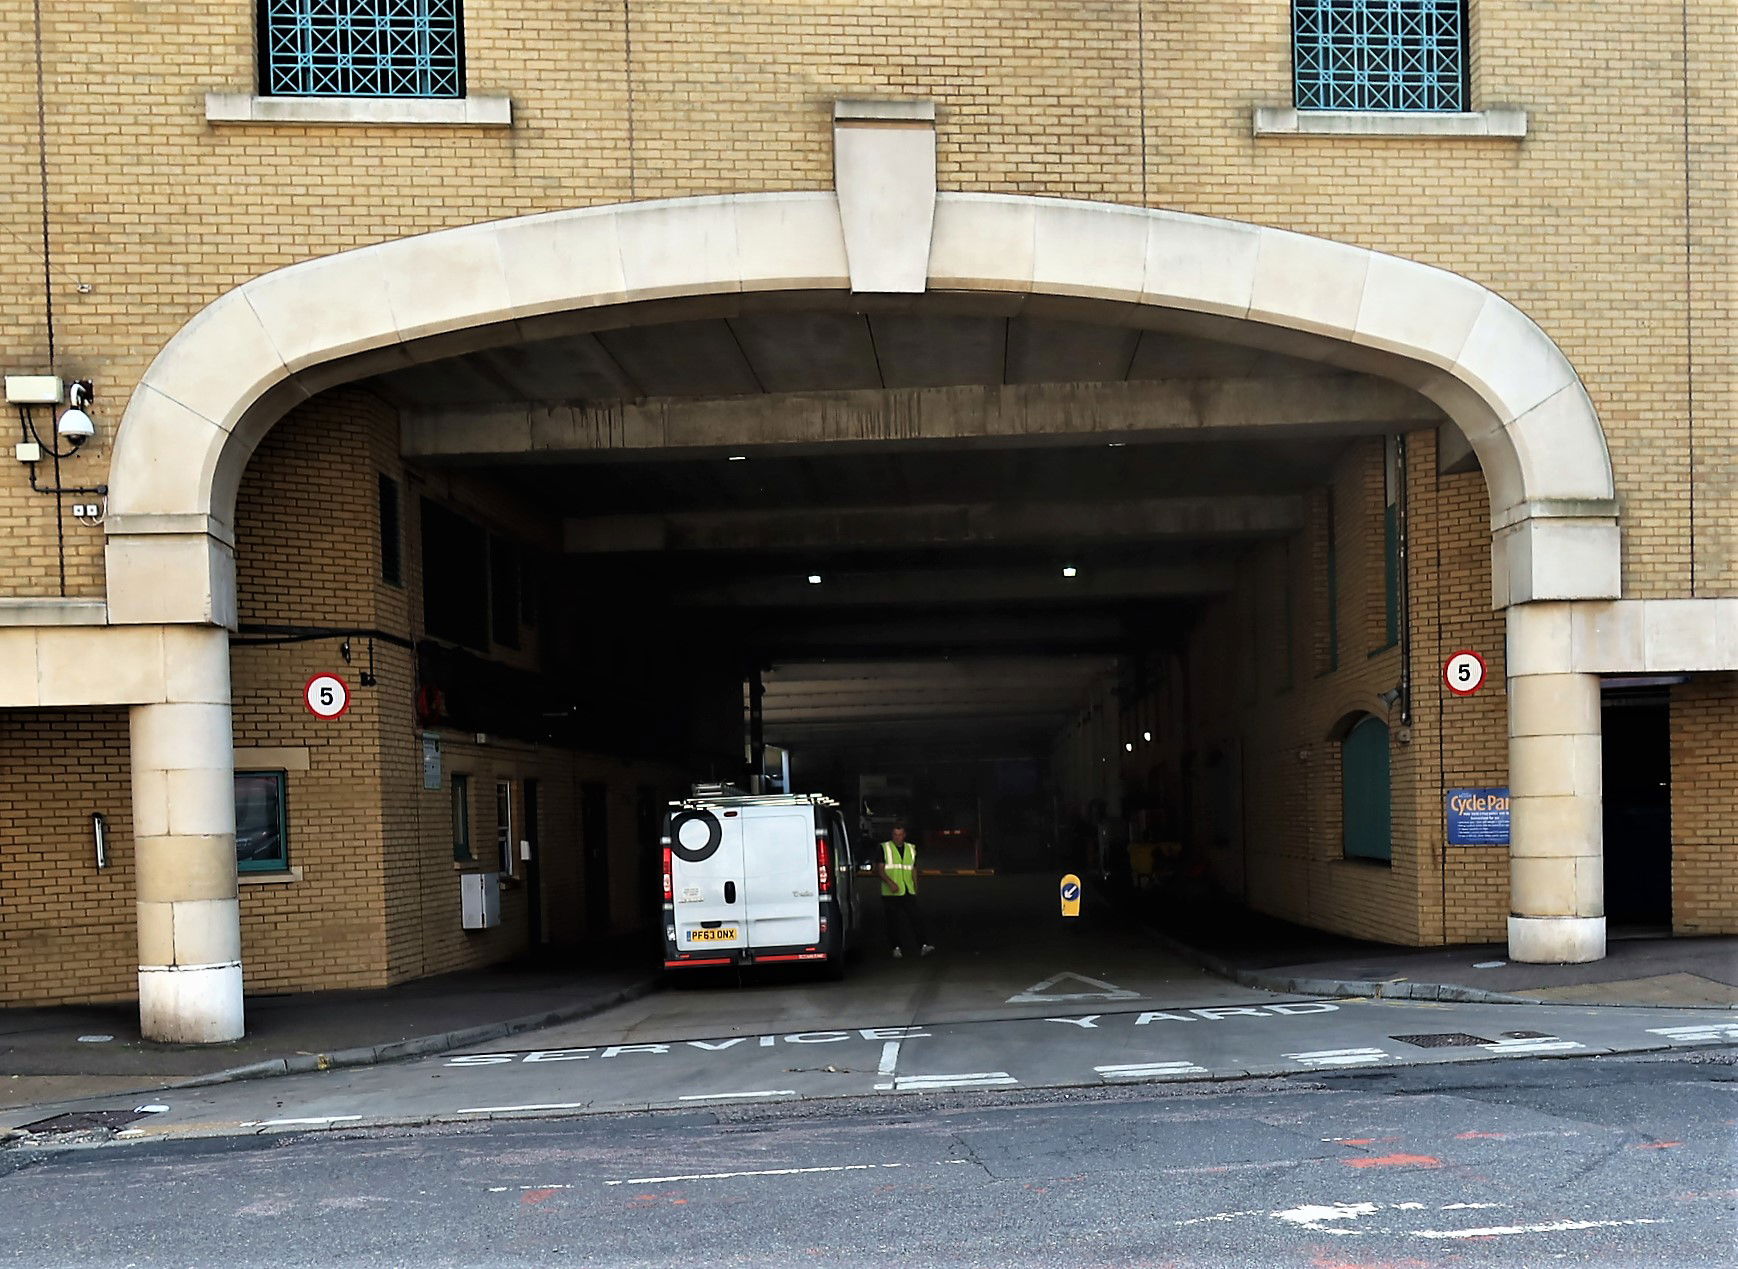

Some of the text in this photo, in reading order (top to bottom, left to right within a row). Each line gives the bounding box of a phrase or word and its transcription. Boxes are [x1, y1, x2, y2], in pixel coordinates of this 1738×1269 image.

[1458, 663, 1471, 681] 5
[320, 687, 333, 705] 5
[1451, 794, 1486, 816] Cycle
[692, 929, 735, 940] PF63 ONX
[443, 1003, 1340, 1067] SERVICE YARD
